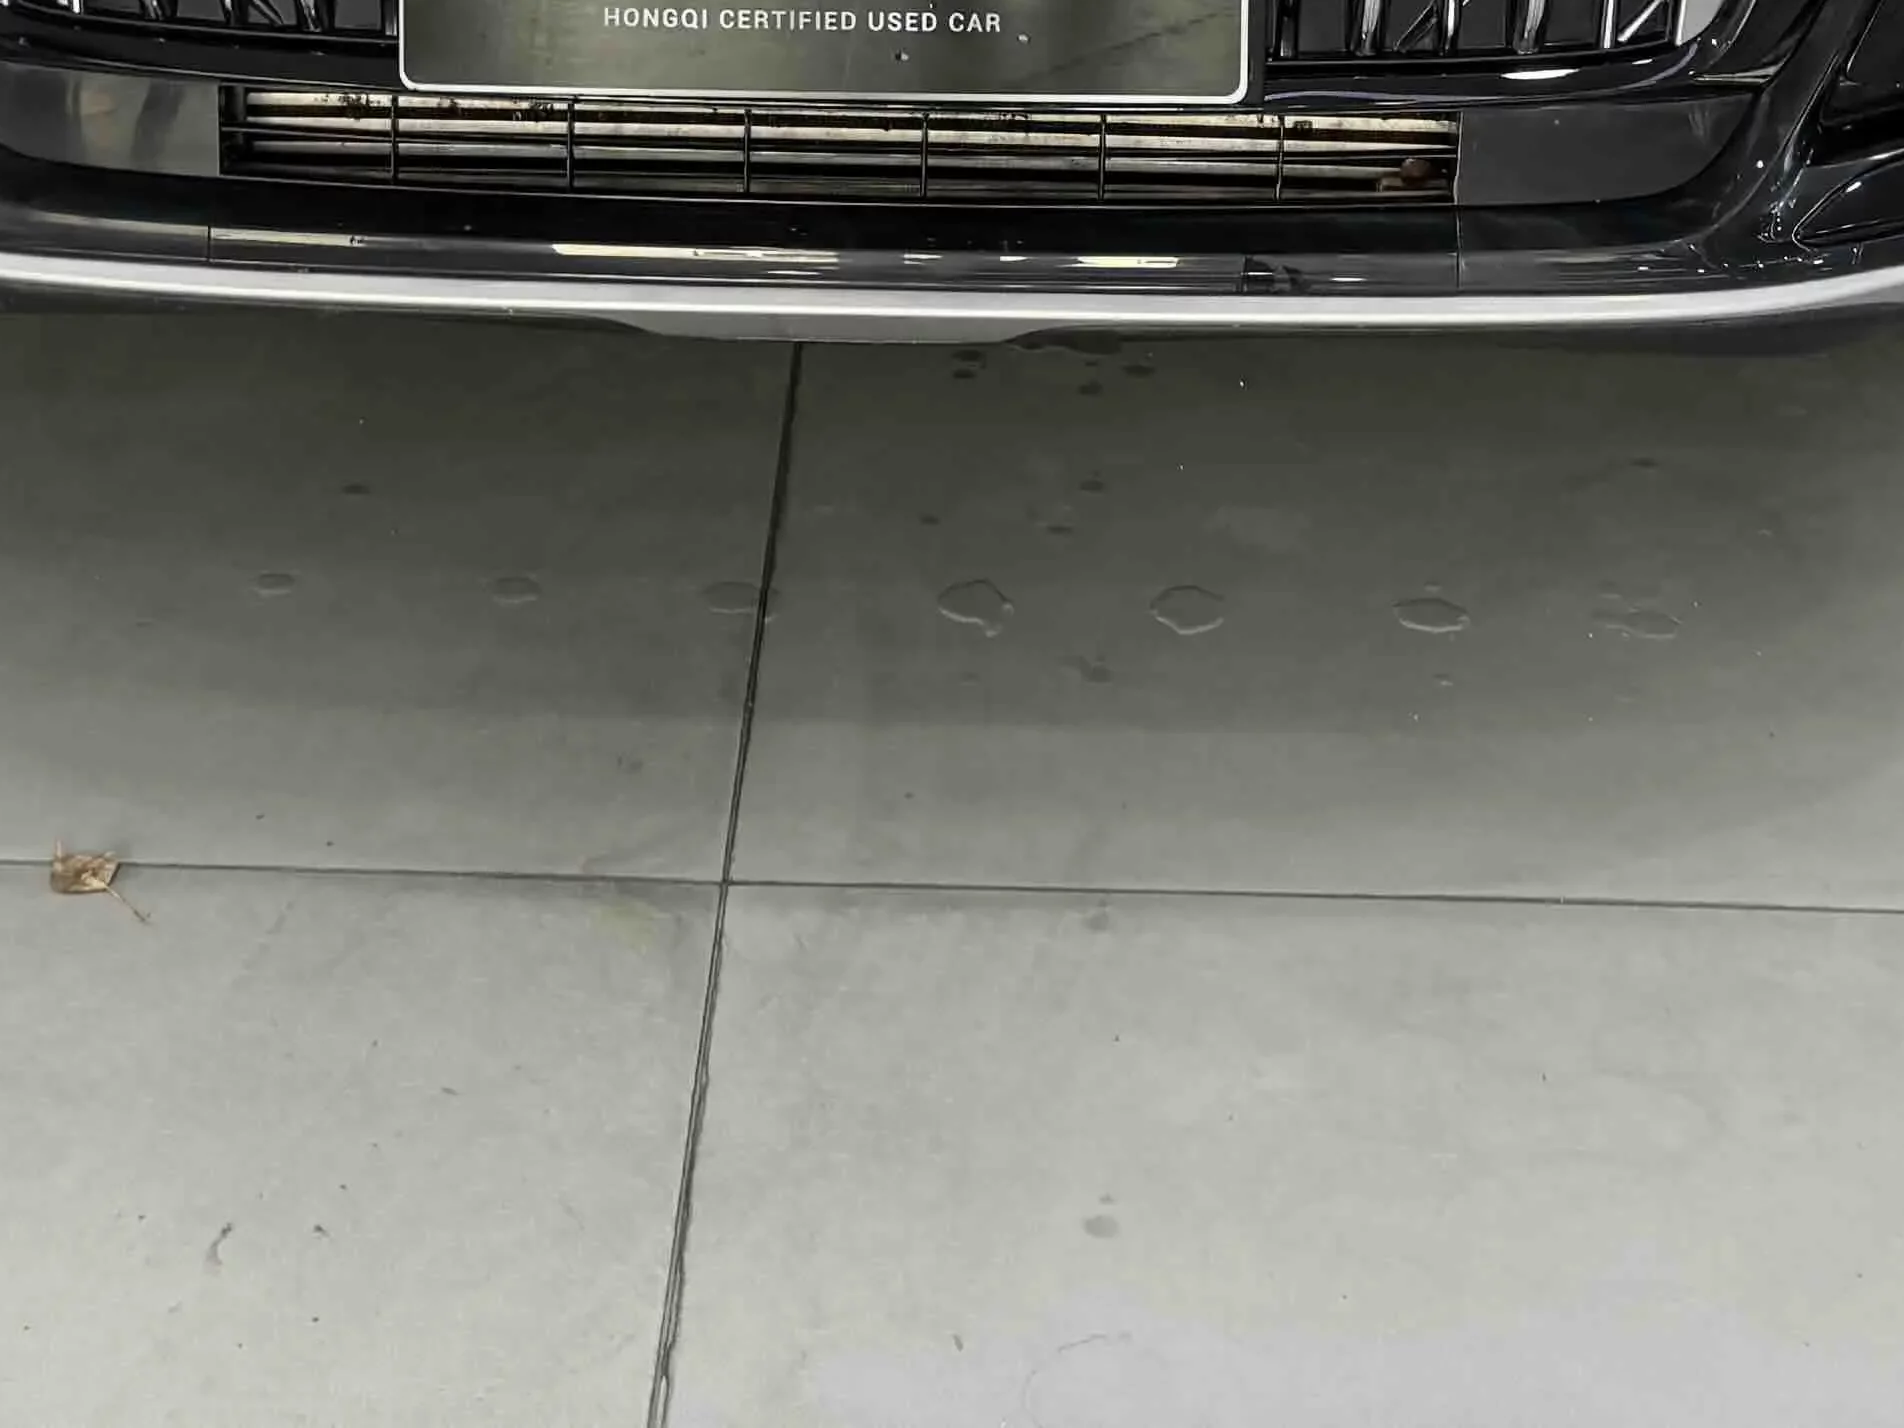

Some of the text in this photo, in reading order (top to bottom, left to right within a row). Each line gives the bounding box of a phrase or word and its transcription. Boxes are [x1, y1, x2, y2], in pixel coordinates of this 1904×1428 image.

[603, 6, 1002, 34] HONGQI CERTIFIED USED CAR
